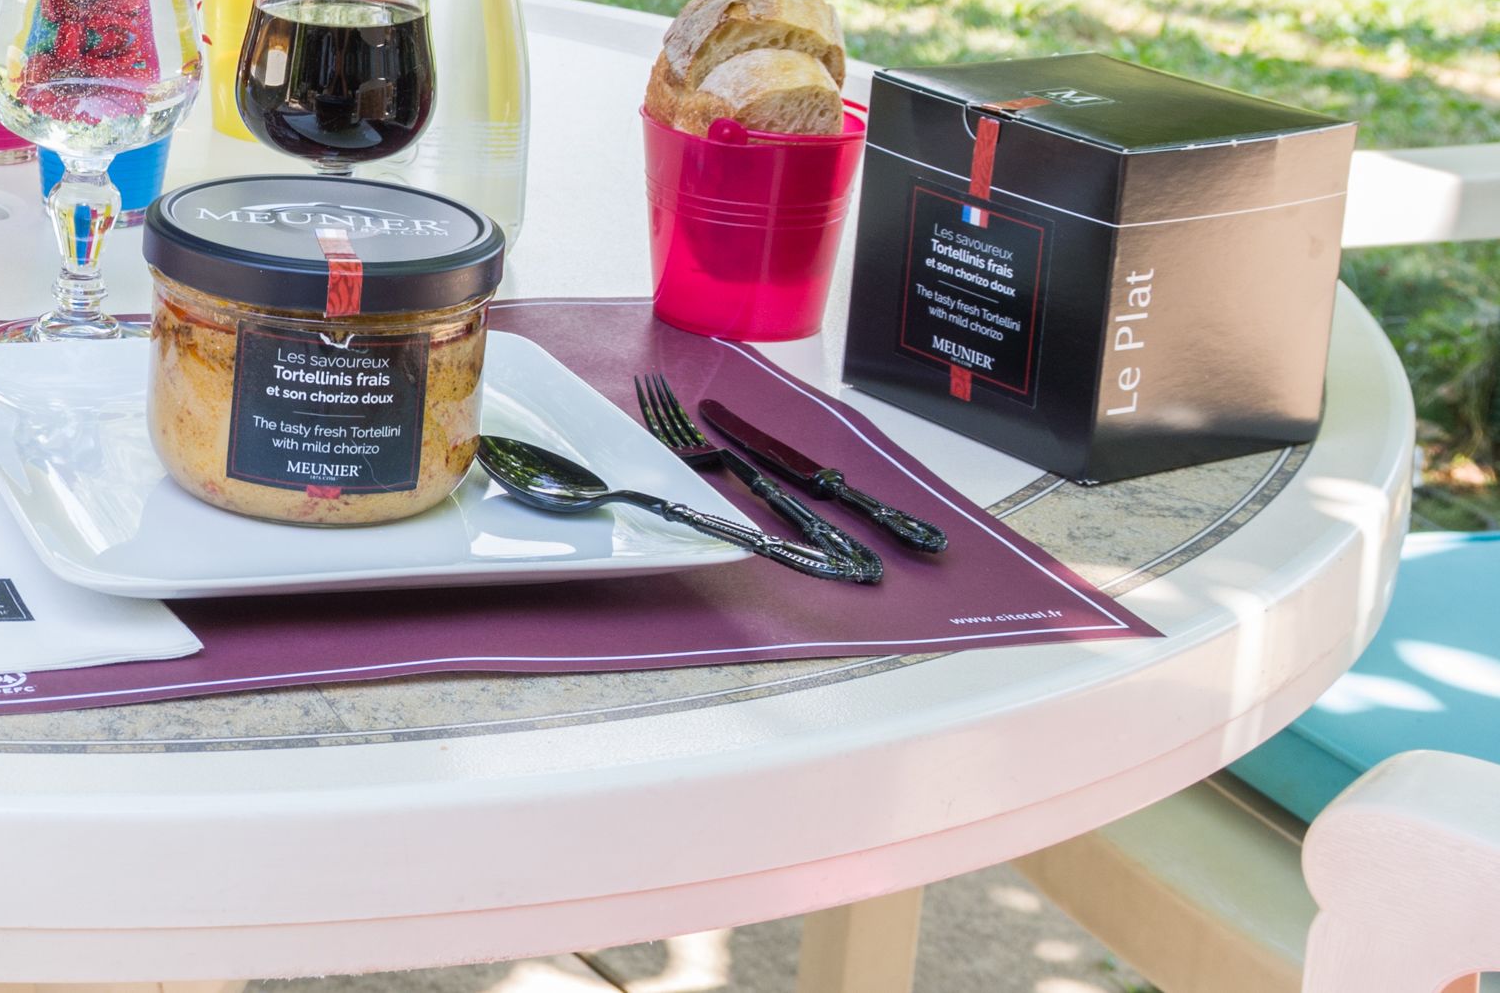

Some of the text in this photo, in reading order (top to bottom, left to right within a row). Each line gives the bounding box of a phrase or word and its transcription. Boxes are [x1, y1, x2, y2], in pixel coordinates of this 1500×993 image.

[934, 223, 1015, 261] Les savoureux
[930, 238, 1015, 279] Tortellinis frais
[925, 257, 1017, 298] et son chorizo doux
[916, 283, 1022, 332] The tasty fresh Tortellini
[928, 305, 1005, 342] with mild chorizo
[1105, 267, 1155, 416] Le Plat
[277, 347, 391, 369] Les savoureux
[273, 364, 391, 387] Tortellinis frais
[265, 385, 394, 404] et son chorizo doux
[252, 415, 402, 439] The tasty fresh Tortellini
[272, 437, 380, 455] with mild chorizo
[949, 609, 1064, 625] www.citotel.fr
